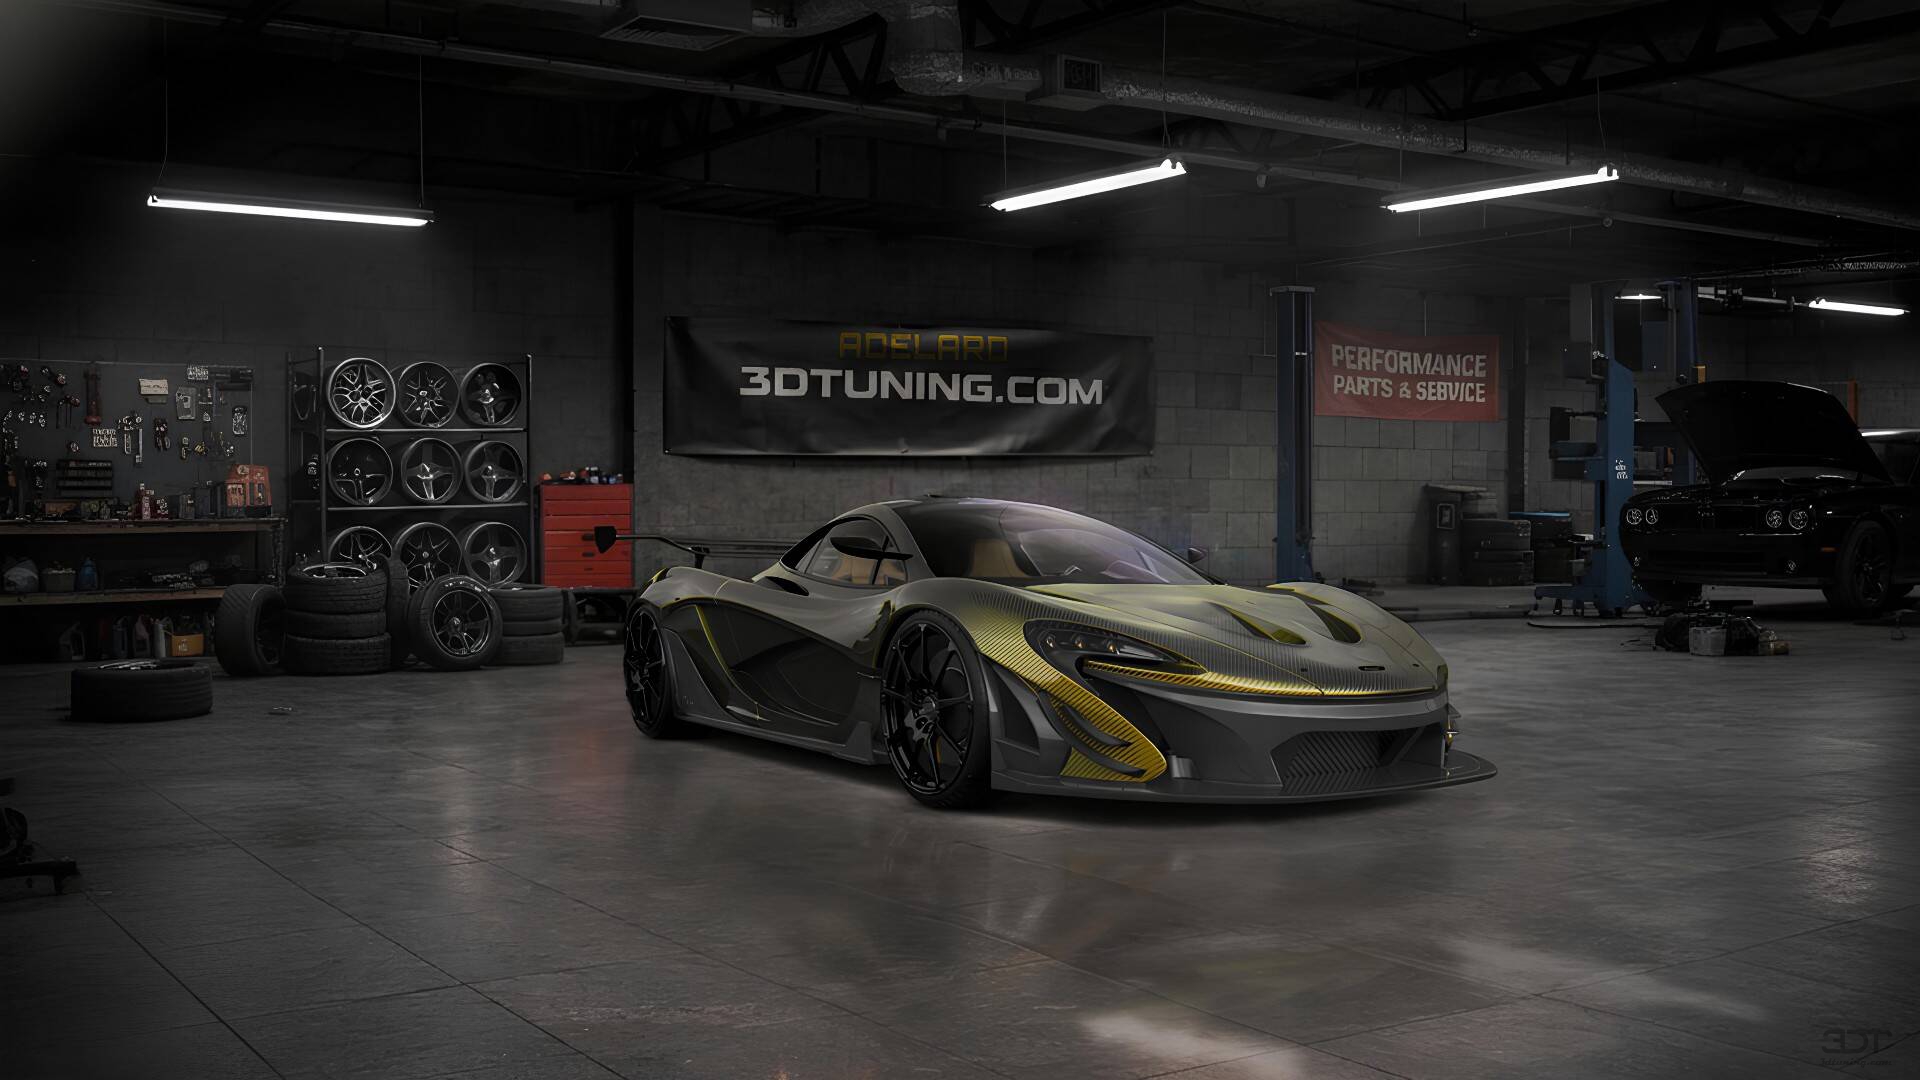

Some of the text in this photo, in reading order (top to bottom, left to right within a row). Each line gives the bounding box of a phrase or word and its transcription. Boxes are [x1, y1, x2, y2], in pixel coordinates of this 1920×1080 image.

[1331, 344, 1487, 377] PERFORMANCE
[739, 366, 1104, 405] 3DTUNING.COM
[1333, 375, 1486, 402] PARTS & SERVICE
